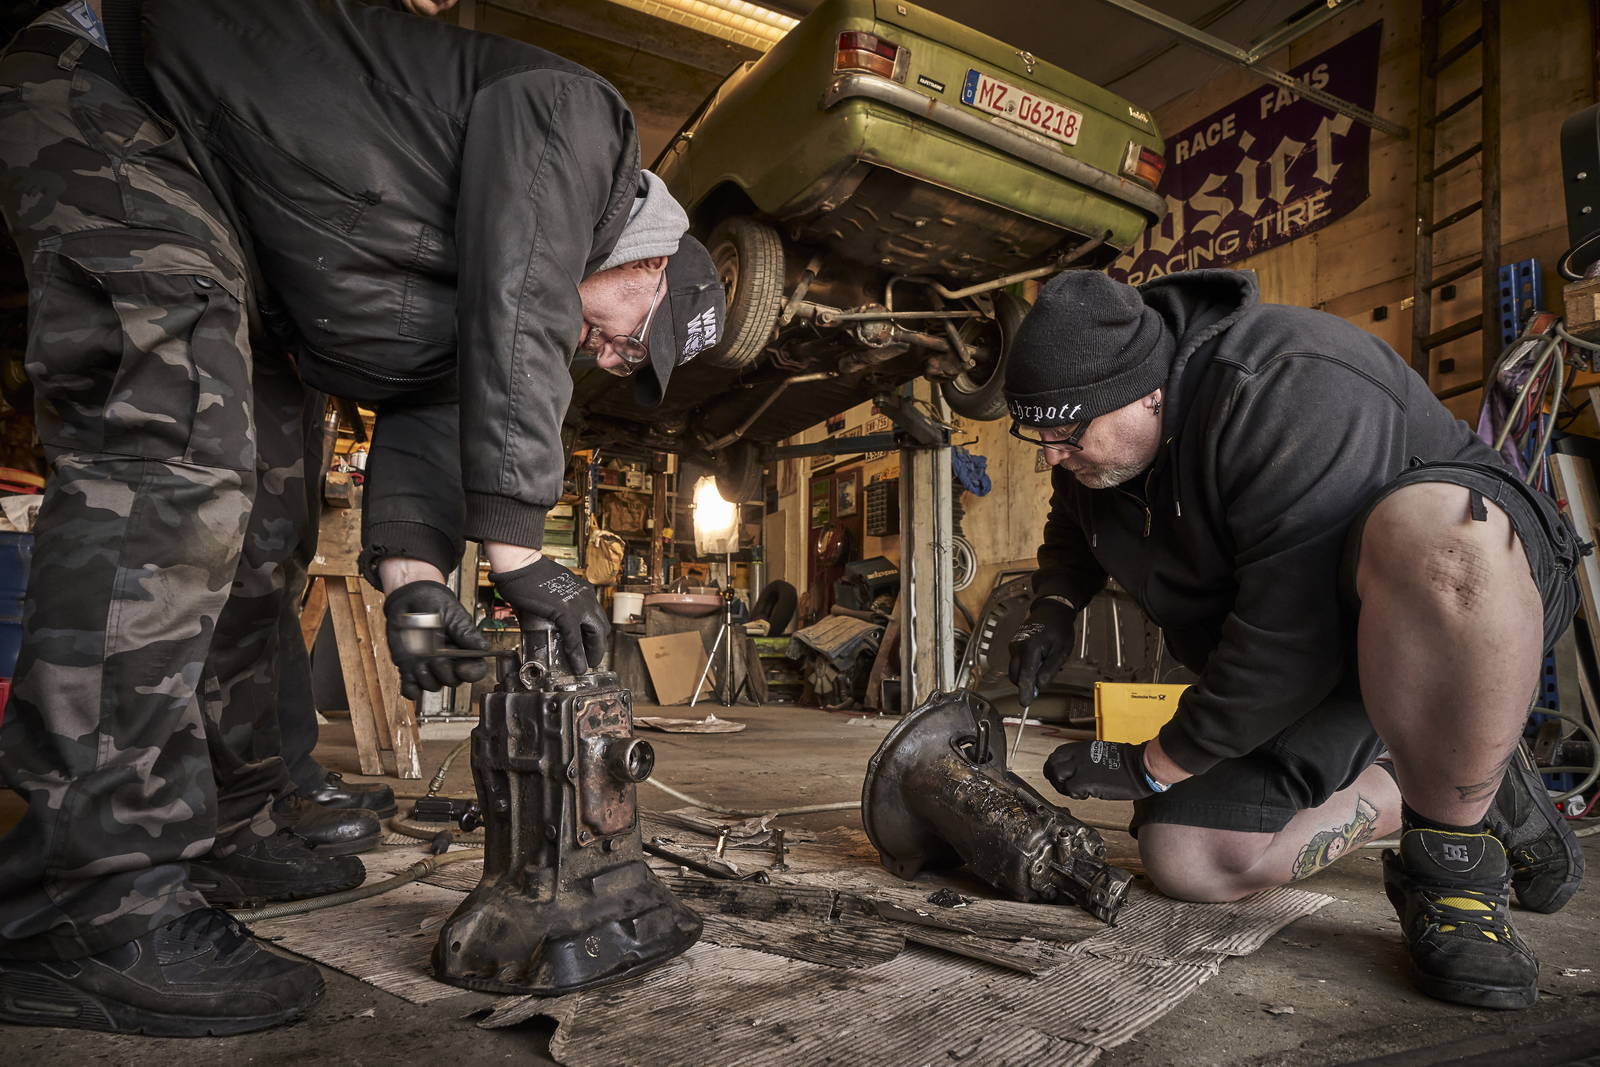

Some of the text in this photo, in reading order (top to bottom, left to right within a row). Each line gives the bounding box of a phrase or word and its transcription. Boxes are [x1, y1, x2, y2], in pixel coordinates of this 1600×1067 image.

[1018, 95, 1077, 138] 06218
[1175, 113, 1237, 165] RACE
[1127, 189, 1333, 287] RACING TIRE
